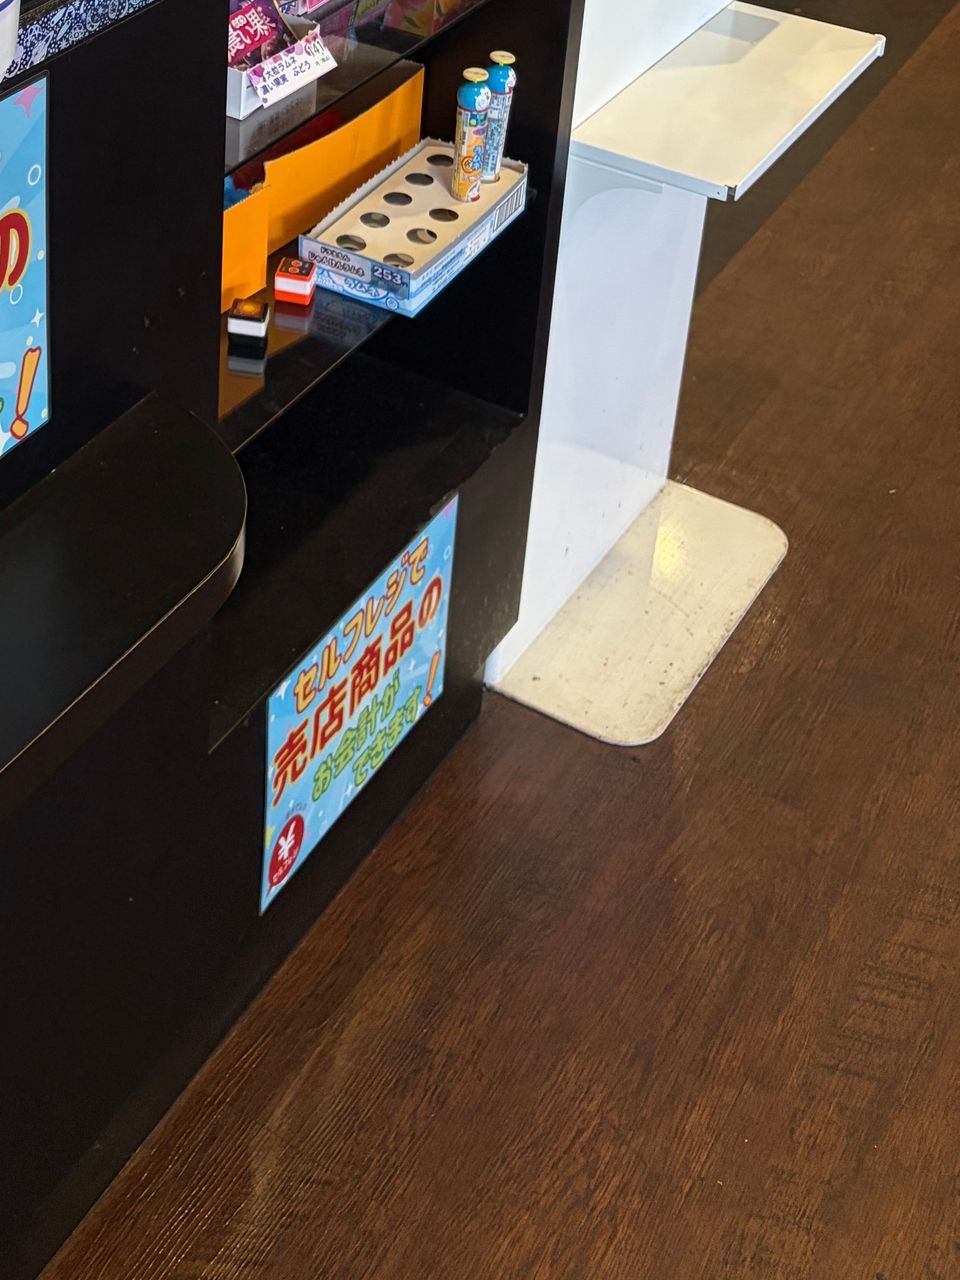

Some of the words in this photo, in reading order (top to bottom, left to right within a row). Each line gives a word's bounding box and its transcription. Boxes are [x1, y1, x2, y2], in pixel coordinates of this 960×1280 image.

[265, 56, 297, 79] 大粒ラムネ
[293, 60, 311, 77] ぶどう
[271, 574, 444, 810] 売店商品の
[293, 535, 430, 715] セルフレジで
[311, 666, 401, 803] お会計が
